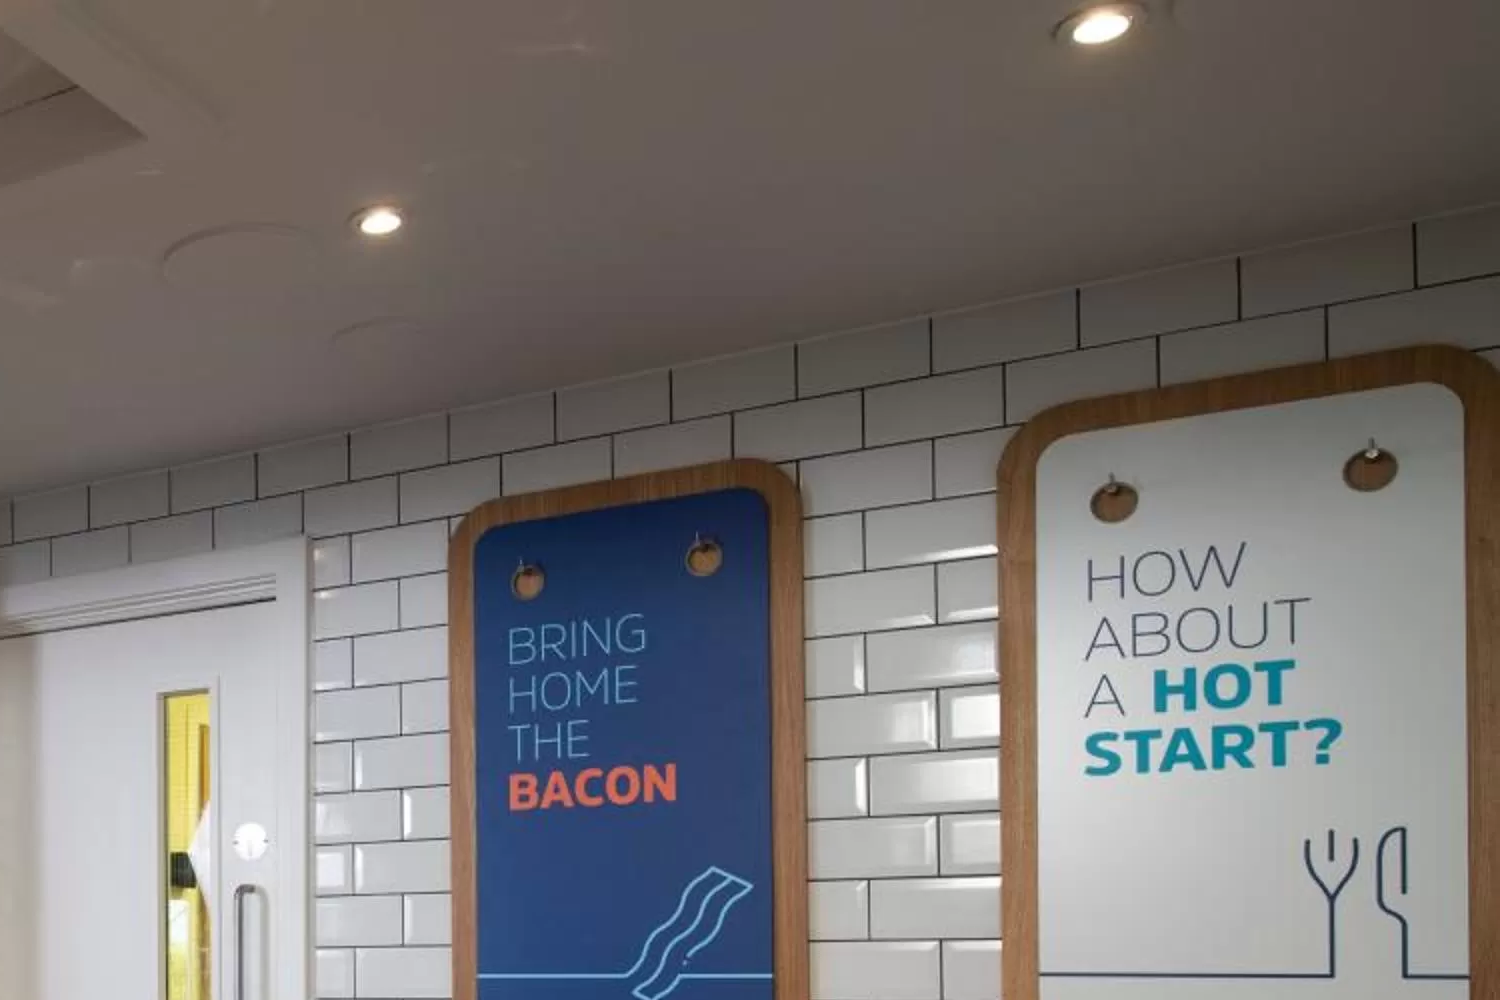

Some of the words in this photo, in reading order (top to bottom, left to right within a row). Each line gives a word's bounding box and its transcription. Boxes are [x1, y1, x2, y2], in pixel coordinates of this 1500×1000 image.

[1087, 541, 1247, 602] HOW
[508, 613, 647, 665] BRING
[1084, 597, 1312, 661] ABOUT
[509, 665, 638, 713] HOME
[1085, 673, 1125, 718] A
[1154, 659, 1295, 713] HOT
[508, 720, 589, 762] THE
[1084, 717, 1343, 776] START?
[509, 763, 676, 811] BACON
